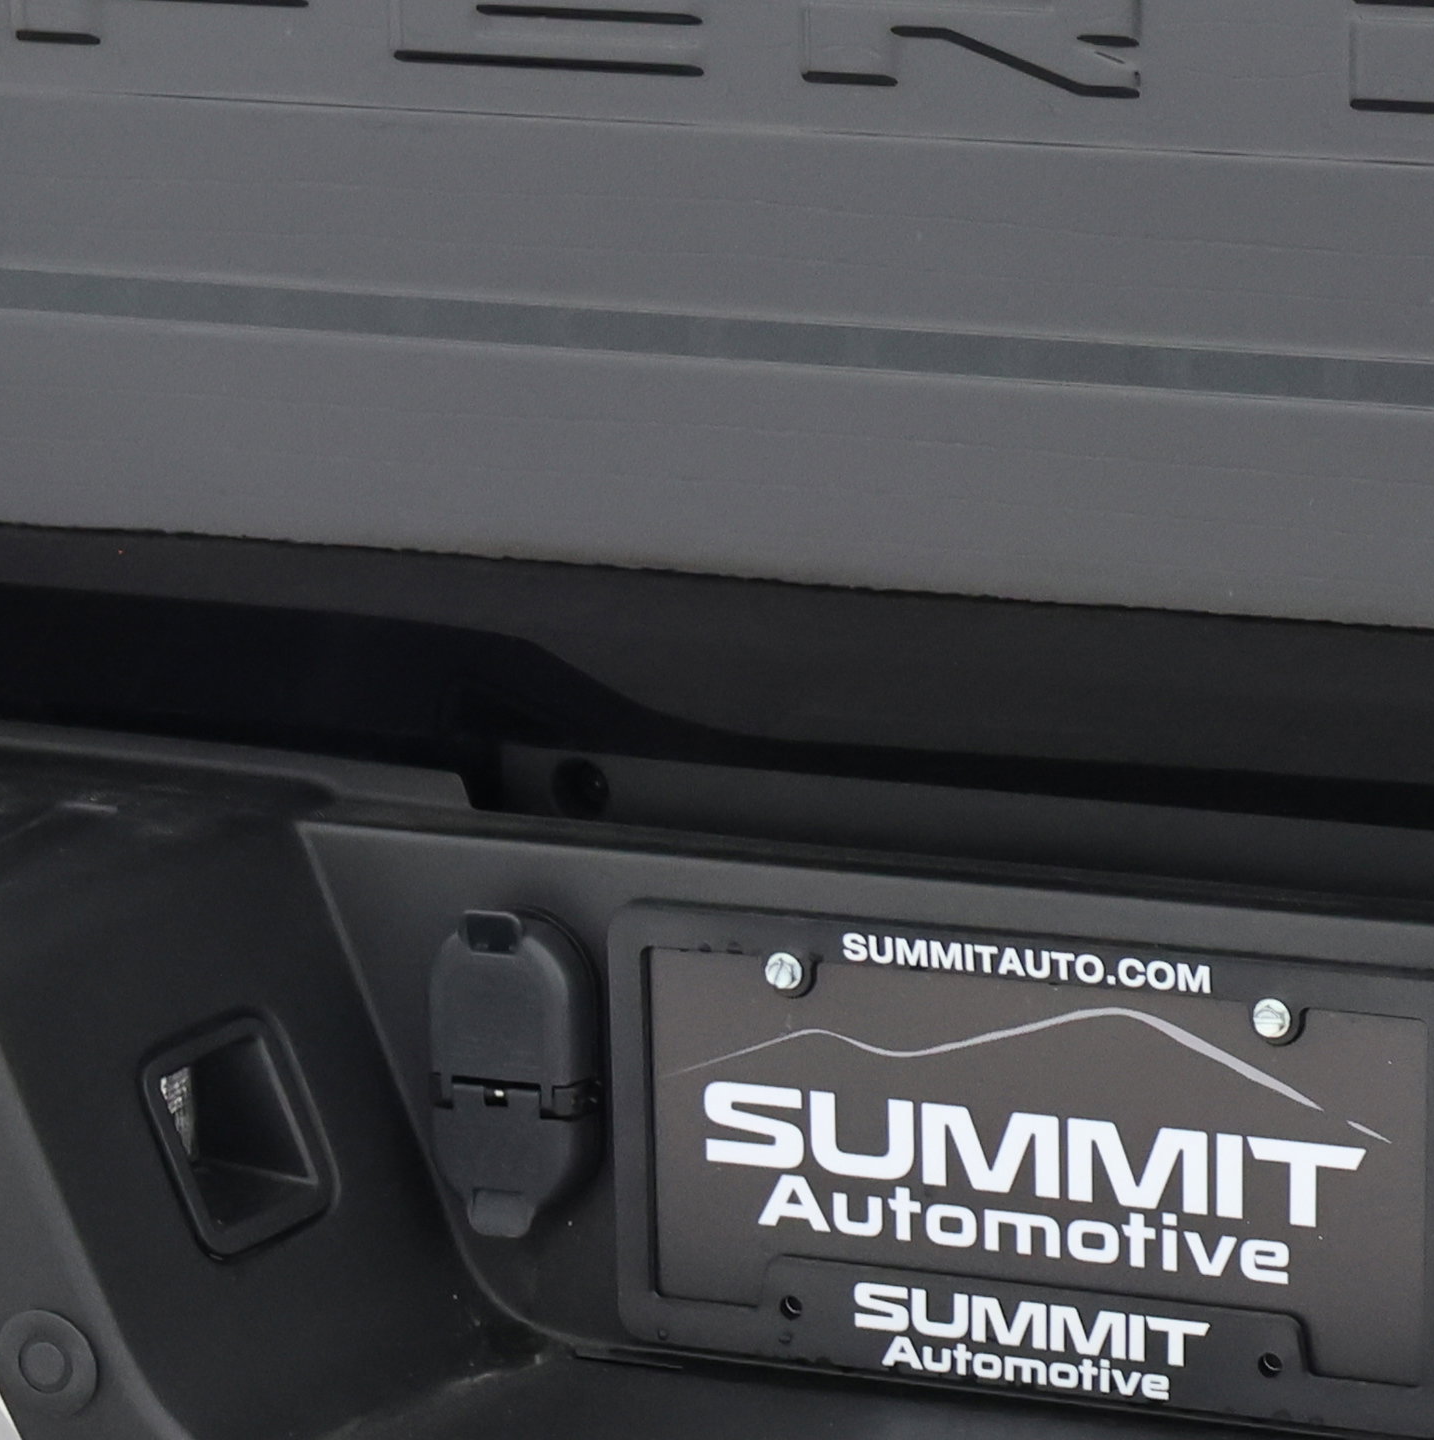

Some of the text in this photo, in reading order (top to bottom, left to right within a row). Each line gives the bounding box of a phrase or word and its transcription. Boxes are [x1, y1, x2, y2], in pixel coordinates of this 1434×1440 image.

[842, 932, 1213, 995] SUMMITAUTO.COM
[703, 1080, 1367, 1228] SUMMIT
[757, 1173, 1291, 1285] Automotive
[852, 1280, 1212, 1368] SUMMIT
[881, 1334, 1172, 1401] Automotive
